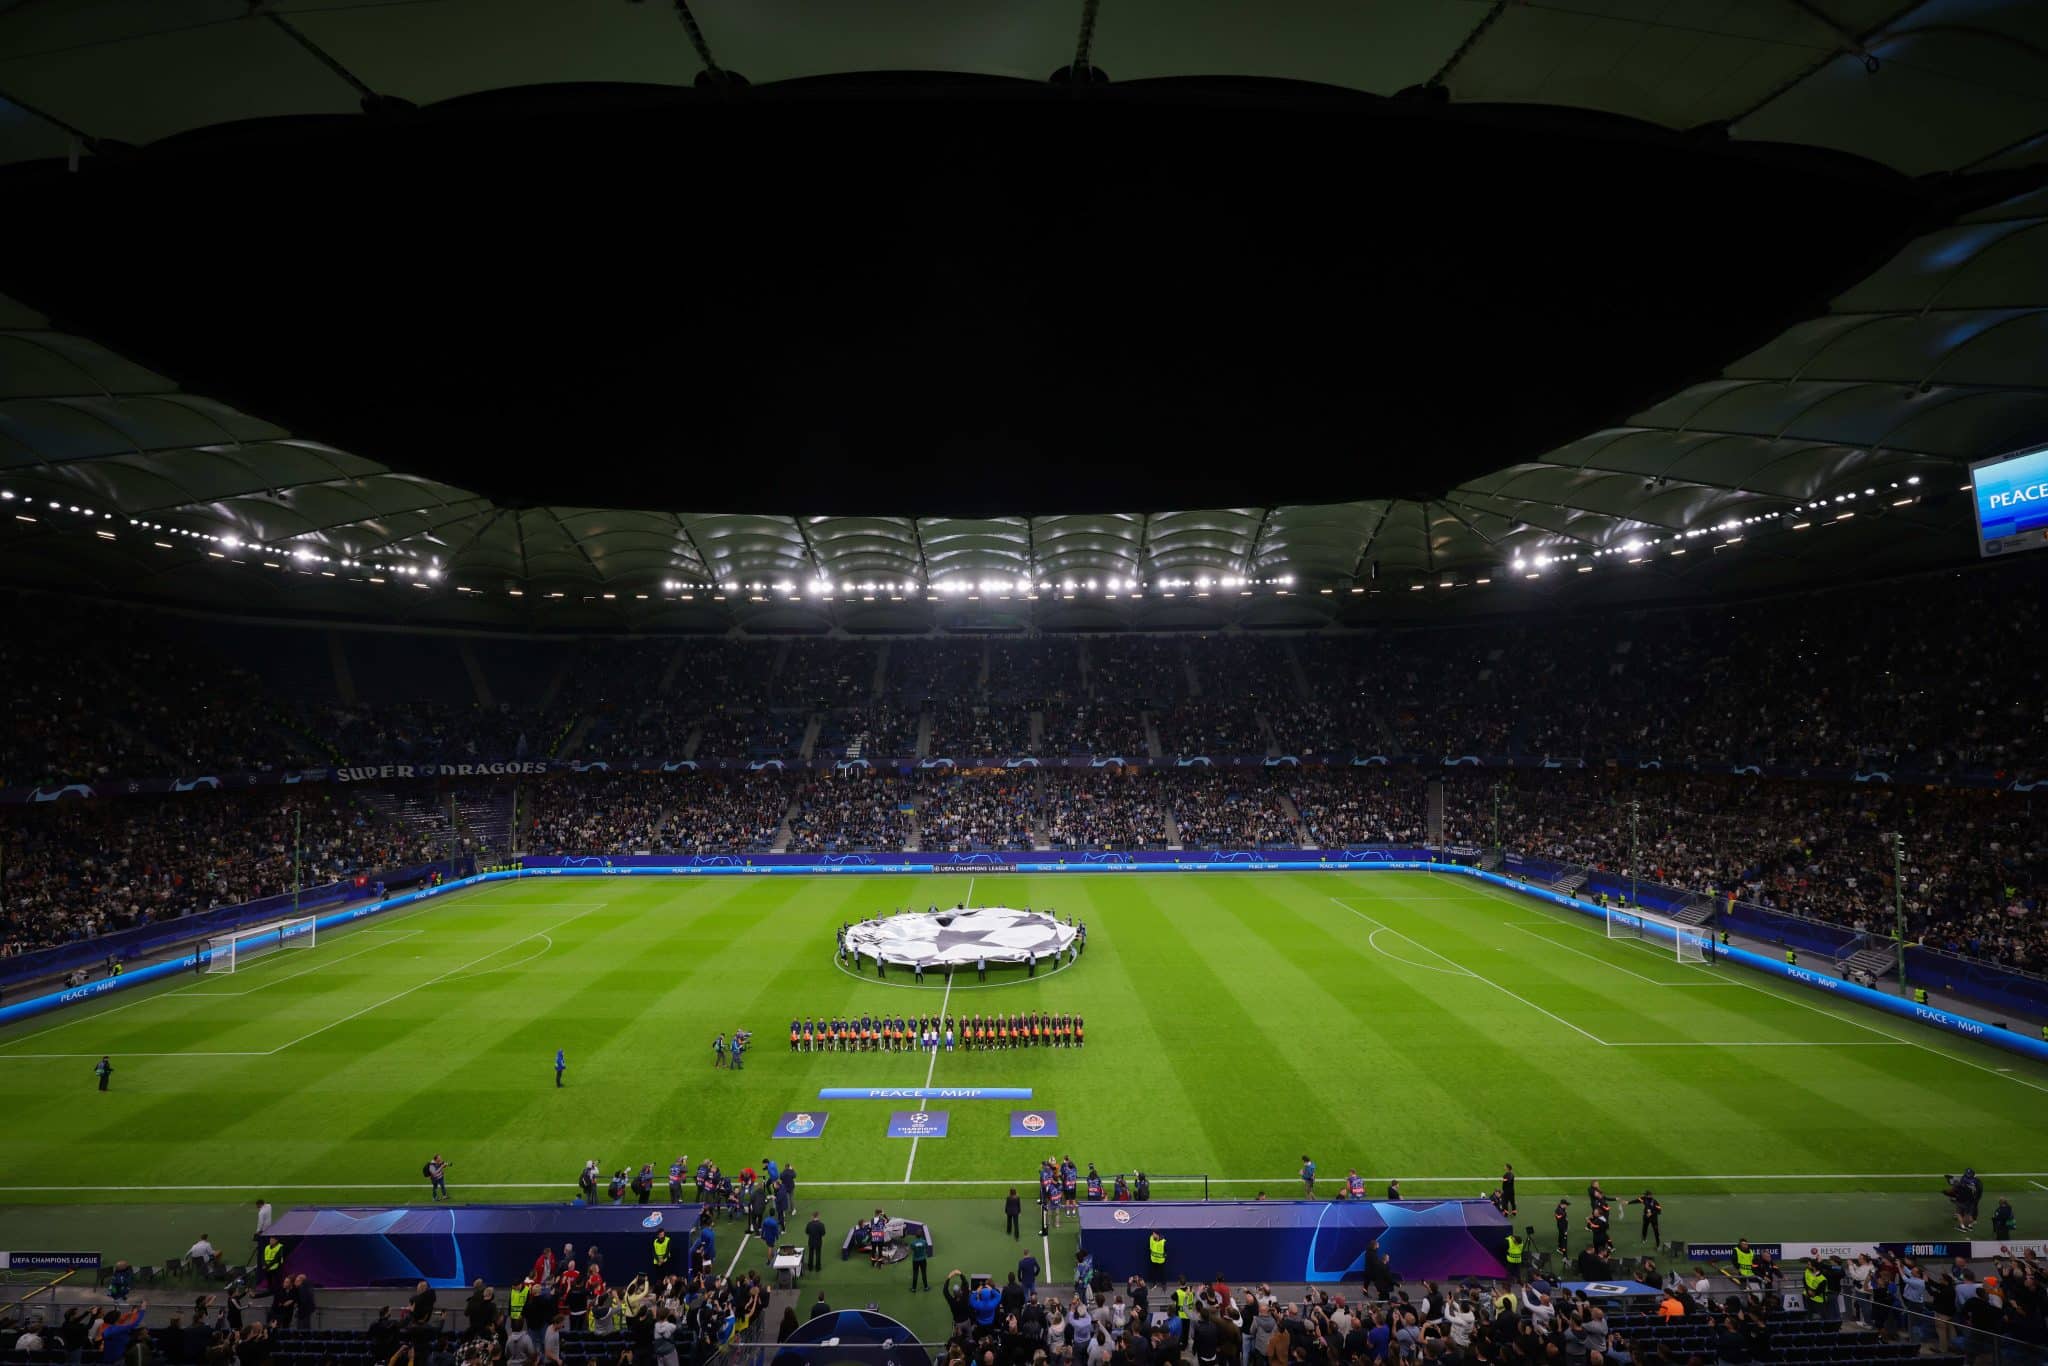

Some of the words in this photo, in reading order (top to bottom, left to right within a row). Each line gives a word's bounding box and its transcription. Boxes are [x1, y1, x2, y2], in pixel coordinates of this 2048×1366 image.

[1990, 483, 2048, 509] PEACE
[337, 764, 414, 782] SUPER
[1787, 967, 1811, 982] PEACE
[60, 988, 88, 1003] PEACE
[1916, 1007, 1948, 1024] PEACE
[1820, 1247, 1852, 1255] RESPECT
[1904, 1244, 1948, 1256] #FOOTBALL
